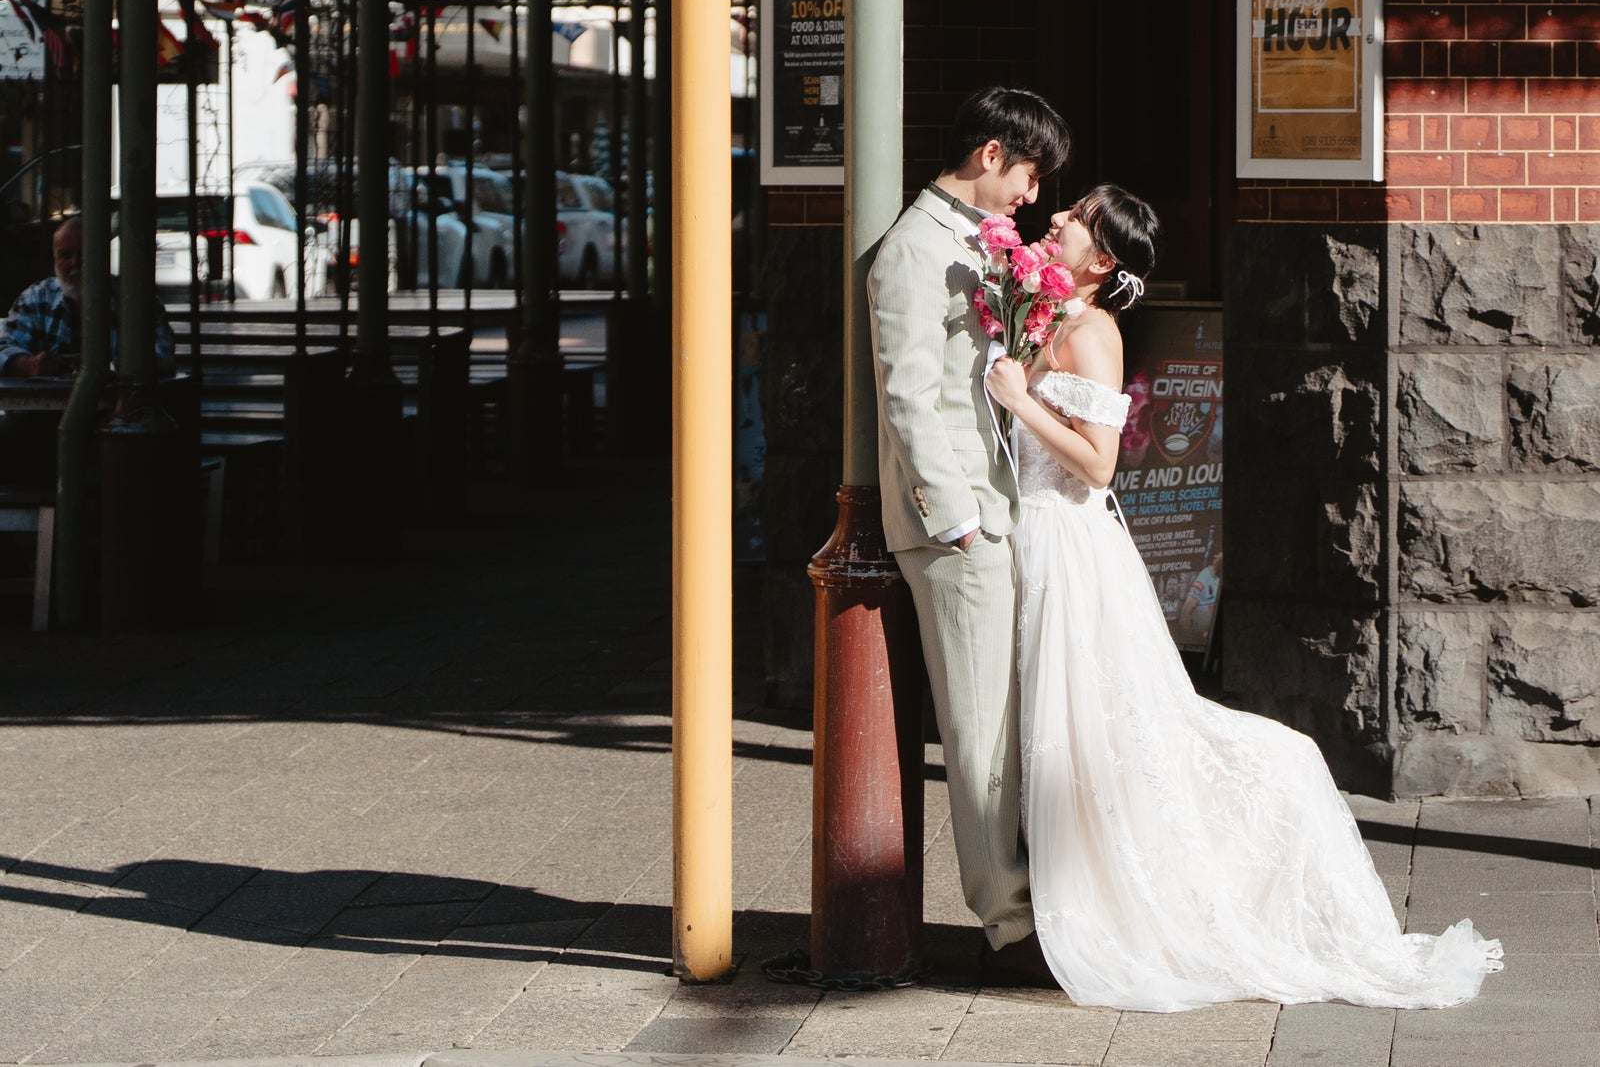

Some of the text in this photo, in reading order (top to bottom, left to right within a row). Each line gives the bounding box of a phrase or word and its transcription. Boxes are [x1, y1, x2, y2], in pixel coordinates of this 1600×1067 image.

[792, 1, 821, 19] 10%
[791, 20, 844, 32] FOOD & DRIN
[1263, 7, 1351, 52] HOUR
[791, 35, 801, 46] AT
[802, 35, 820, 45] OUR
[1167, 364, 1218, 376] STATE OF
[1153, 378, 1223, 398] ORIGIN
[1110, 463, 1223, 492] IVE AND LOU
[1121, 487, 1219, 506] ON THE BIG SCREEN!
[1139, 503, 1178, 515] NATIONAL
[1180, 501, 1205, 513] HOTEL
[1208, 499, 1223, 510] FRE
[1133, 517, 1150, 527] KICK
[1150, 516, 1164, 526] OFF
[1152, 532, 1174, 542] YOUR
[1174, 530, 1196, 540] MATE
[1161, 561, 1192, 572] SPECIAL
